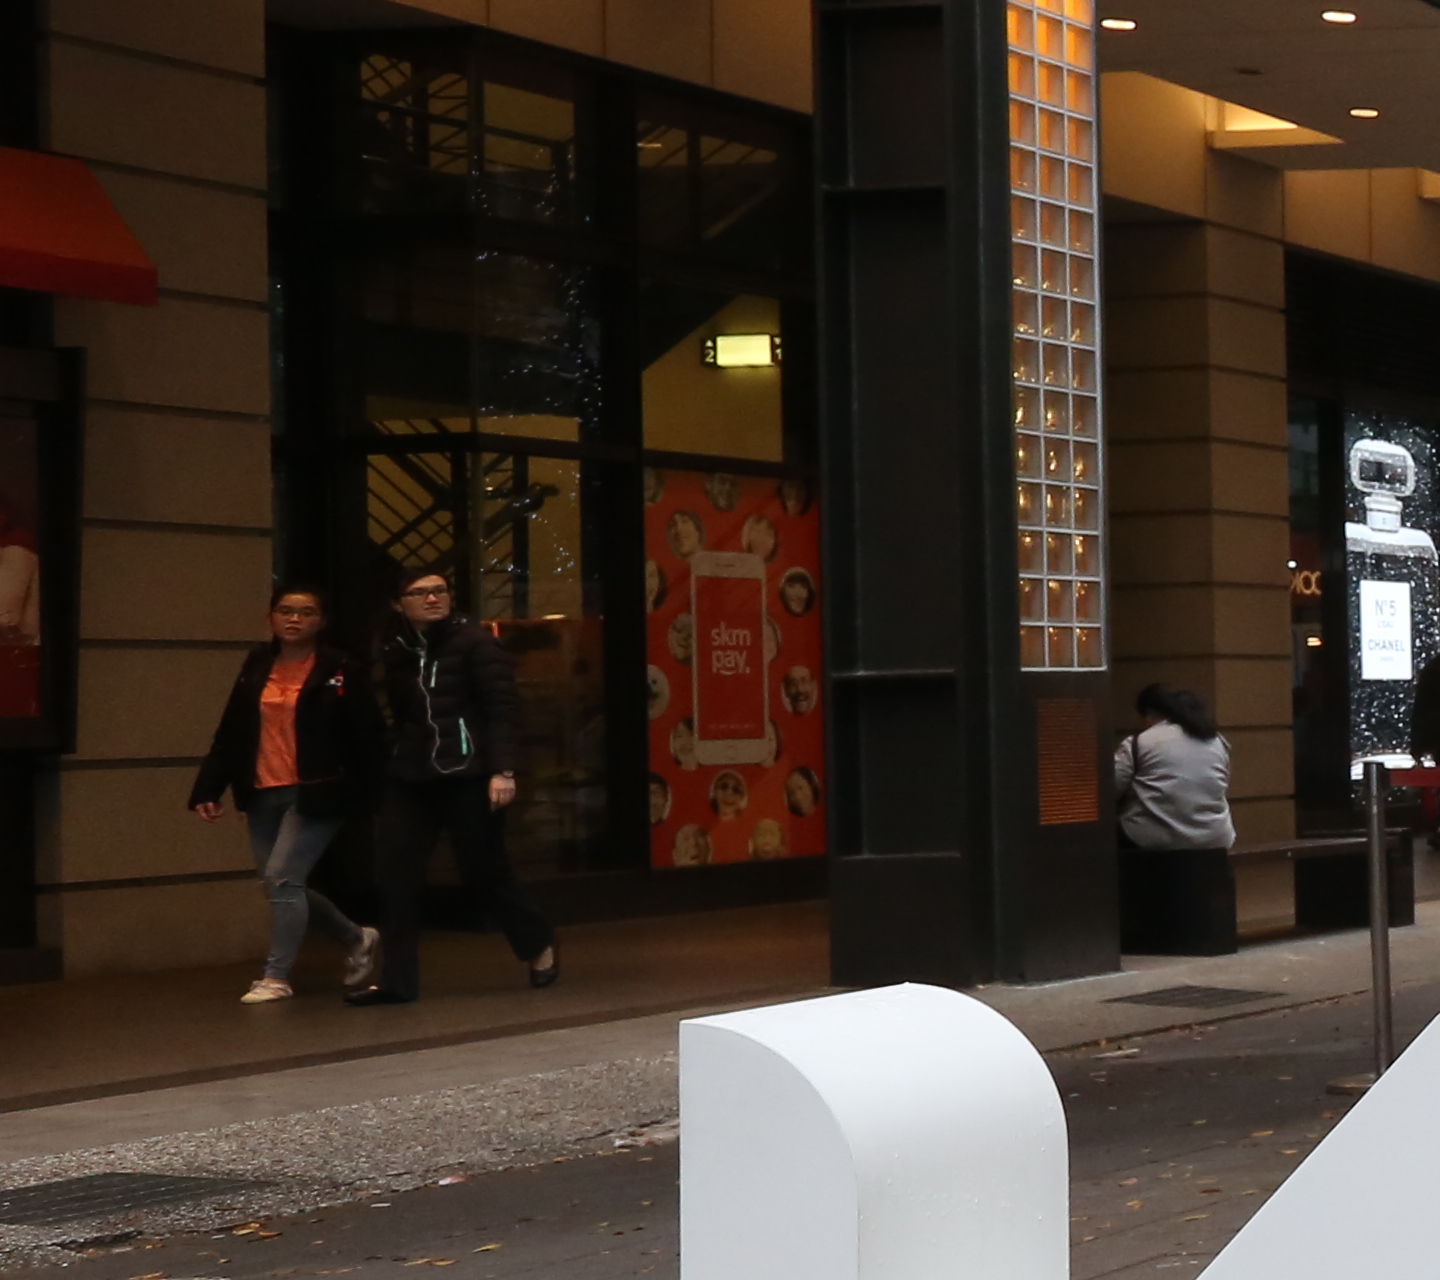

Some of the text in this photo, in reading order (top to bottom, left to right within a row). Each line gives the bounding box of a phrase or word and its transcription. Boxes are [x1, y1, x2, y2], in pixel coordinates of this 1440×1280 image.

[704, 347, 715, 362] 2
[711, 622, 751, 648] skm
[1367, 638, 1405, 652] CHANEL
